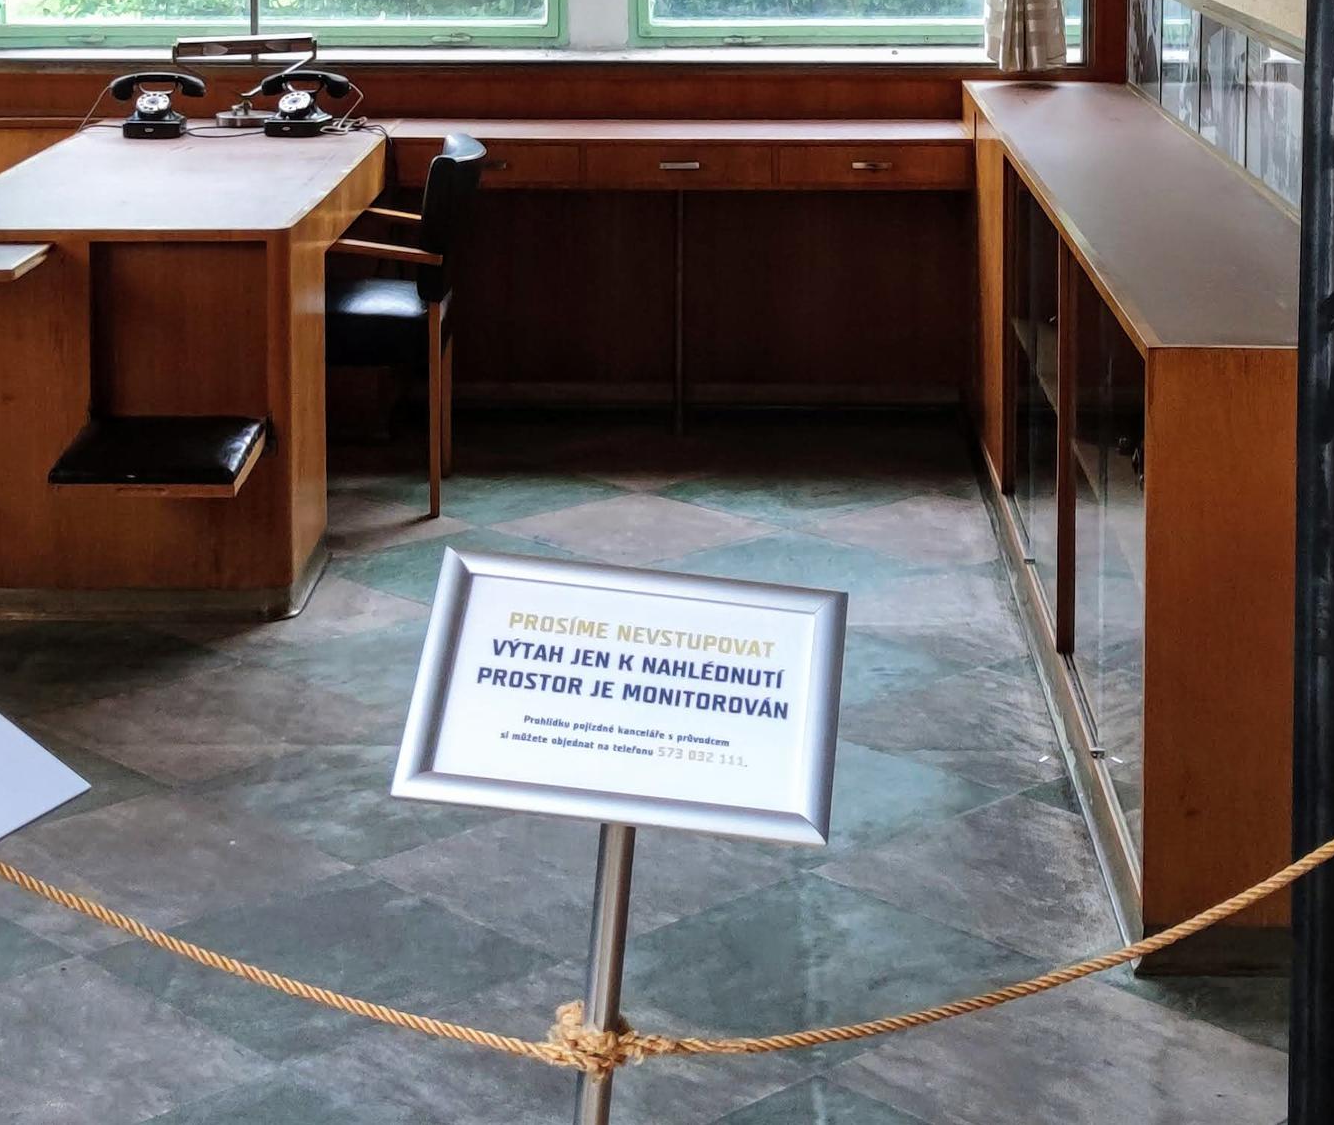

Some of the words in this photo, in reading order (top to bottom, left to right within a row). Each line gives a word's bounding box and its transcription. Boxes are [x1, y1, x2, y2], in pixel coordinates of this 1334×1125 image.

[509, 611, 609, 639] PROSÍME
[617, 624, 776, 658] NEVSTUPOVAT
[493, 638, 564, 663] VÝTAH
[570, 648, 610, 669] JEN
[618, 653, 635, 672] K
[642, 656, 785, 689] NAHLÉDNUTÍ
[477, 666, 583, 696] PROSTOR
[590, 679, 615, 699] JE
[622, 683, 789, 720] MONITOROVÁN
[500, 730, 509, 739] si
[511, 732, 548, 744] můžete
[551, 736, 595, 749] objednat
[597, 742, 610, 751] na
[612, 743, 654, 756] telefonu
[658, 746, 684, 760] 573
[523, 714, 571, 729] Prohlídku
[572, 721, 615, 734] pojízdné
[617, 725, 665, 740] kanceláře
[668, 733, 674, 741] s
[676, 734, 730, 747] průvodcem
